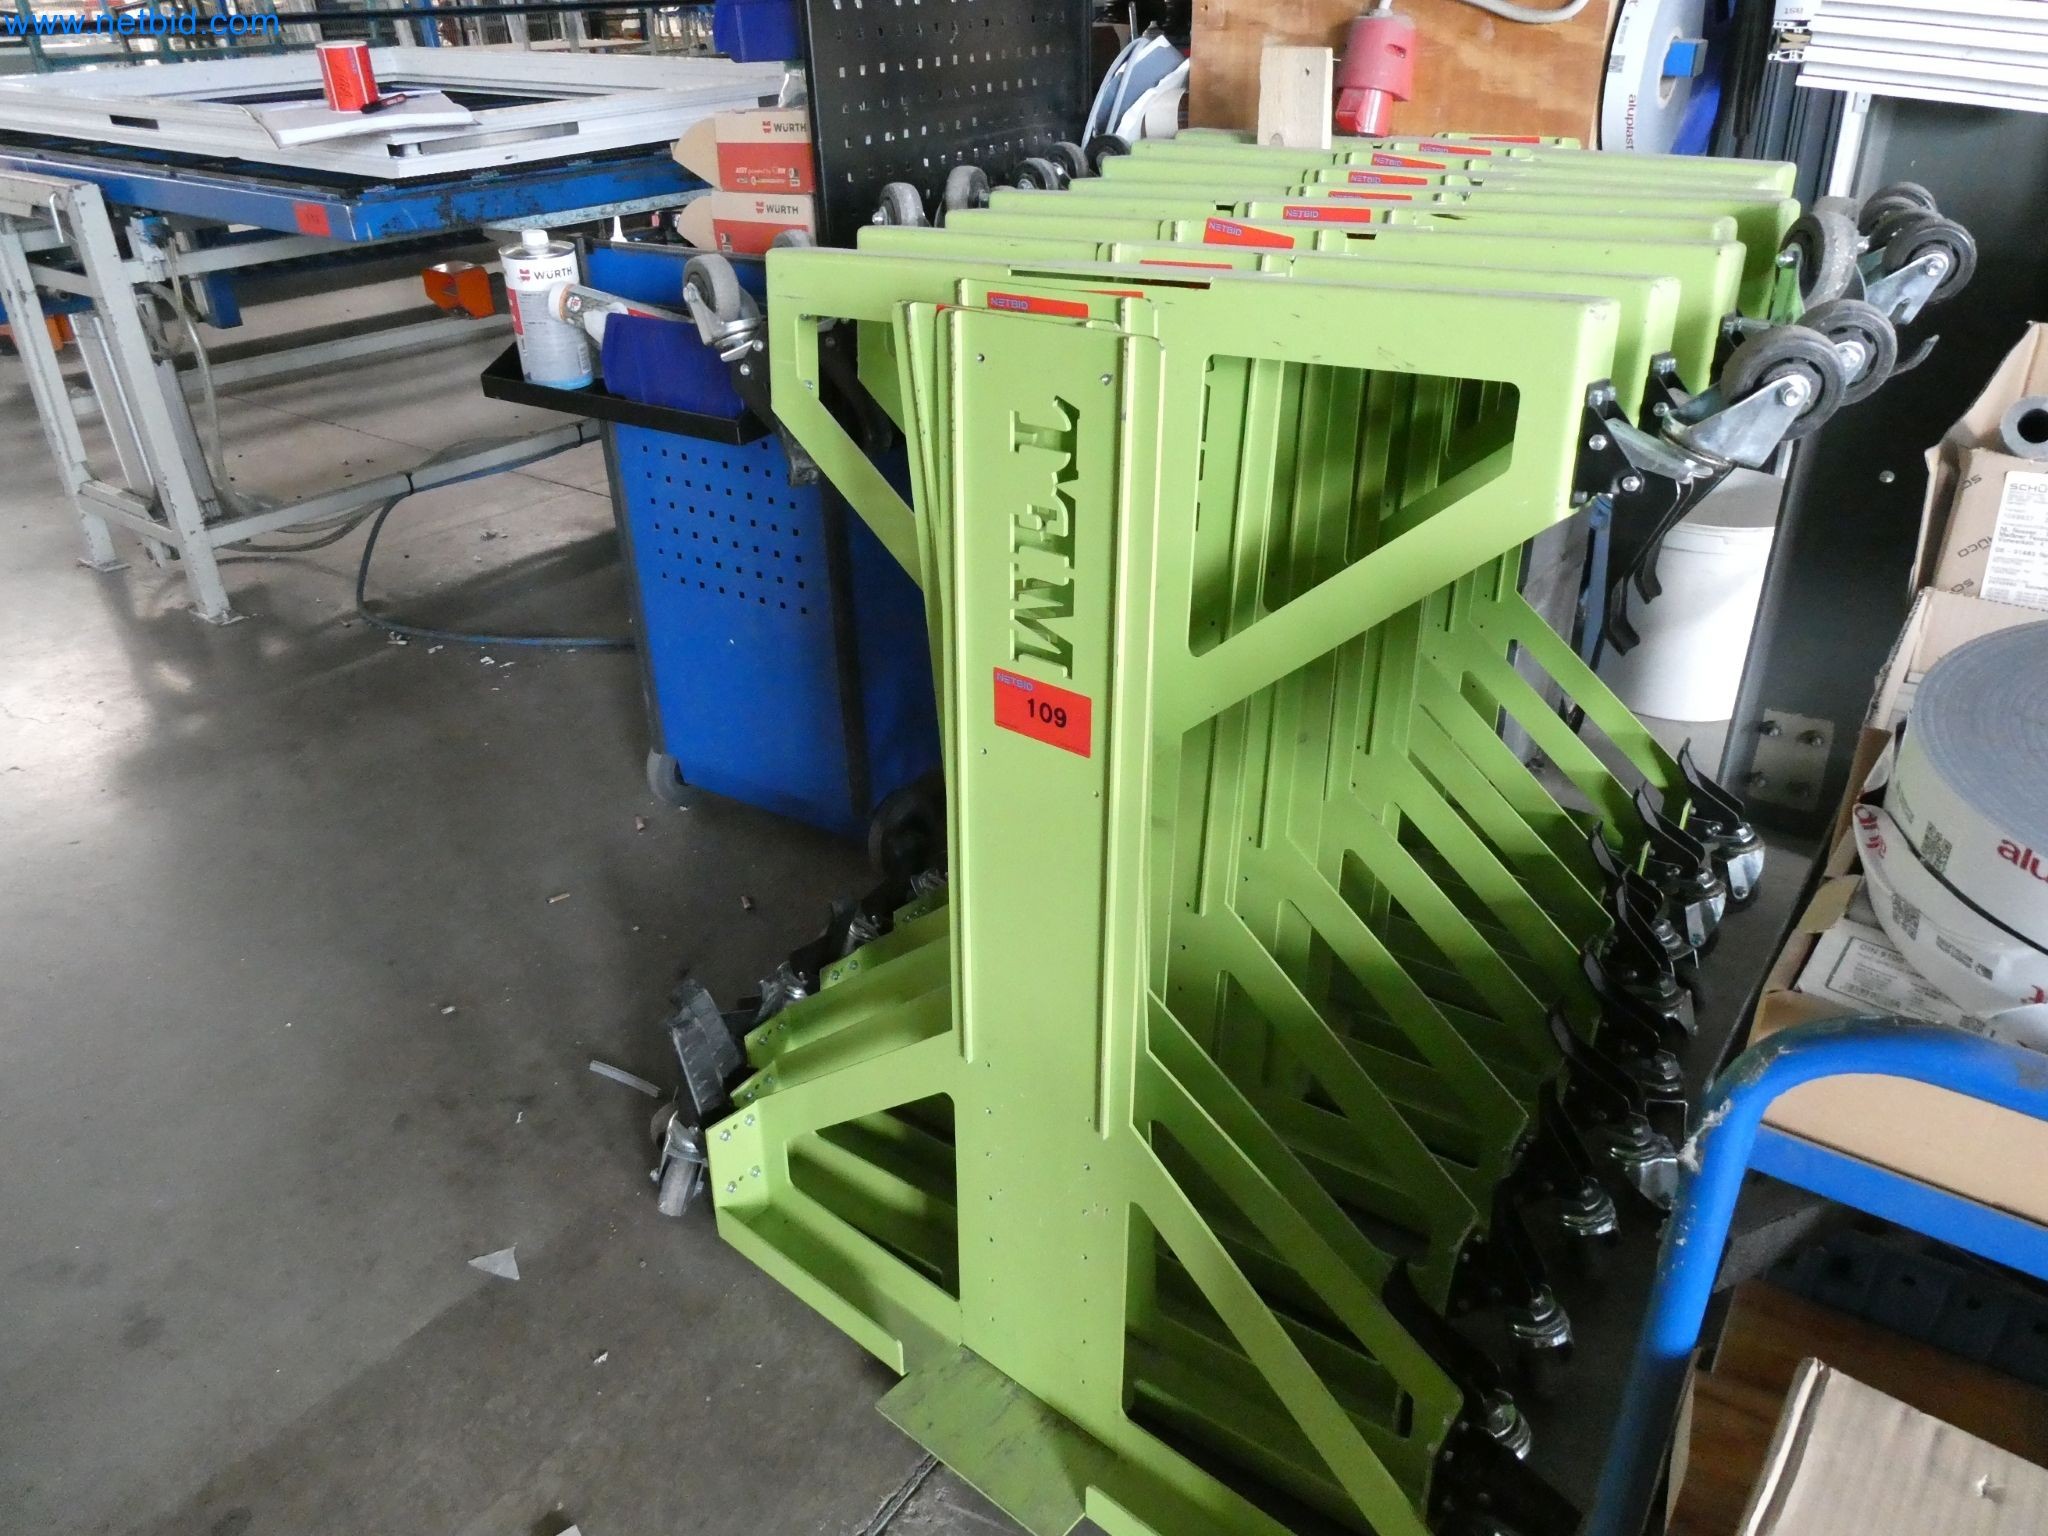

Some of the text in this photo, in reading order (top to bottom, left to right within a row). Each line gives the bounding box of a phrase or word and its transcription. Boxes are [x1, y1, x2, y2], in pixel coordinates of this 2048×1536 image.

[773, 122, 808, 133] WÜRTH
[1626, 93, 1637, 150] aluplast
[1373, 155, 1403, 166] NETBID
[1351, 174, 1382, 184] NETBID
[766, 203, 799, 215] WÜRTH
[1285, 209, 1319, 218] NETBID
[1209, 221, 1242, 236] NETBID
[533, 266, 573, 280] WÜRTH
[991, 297, 1029, 310] NETBID
[997, 672, 1034, 692] NETBID
[1027, 698, 1067, 728] 109
